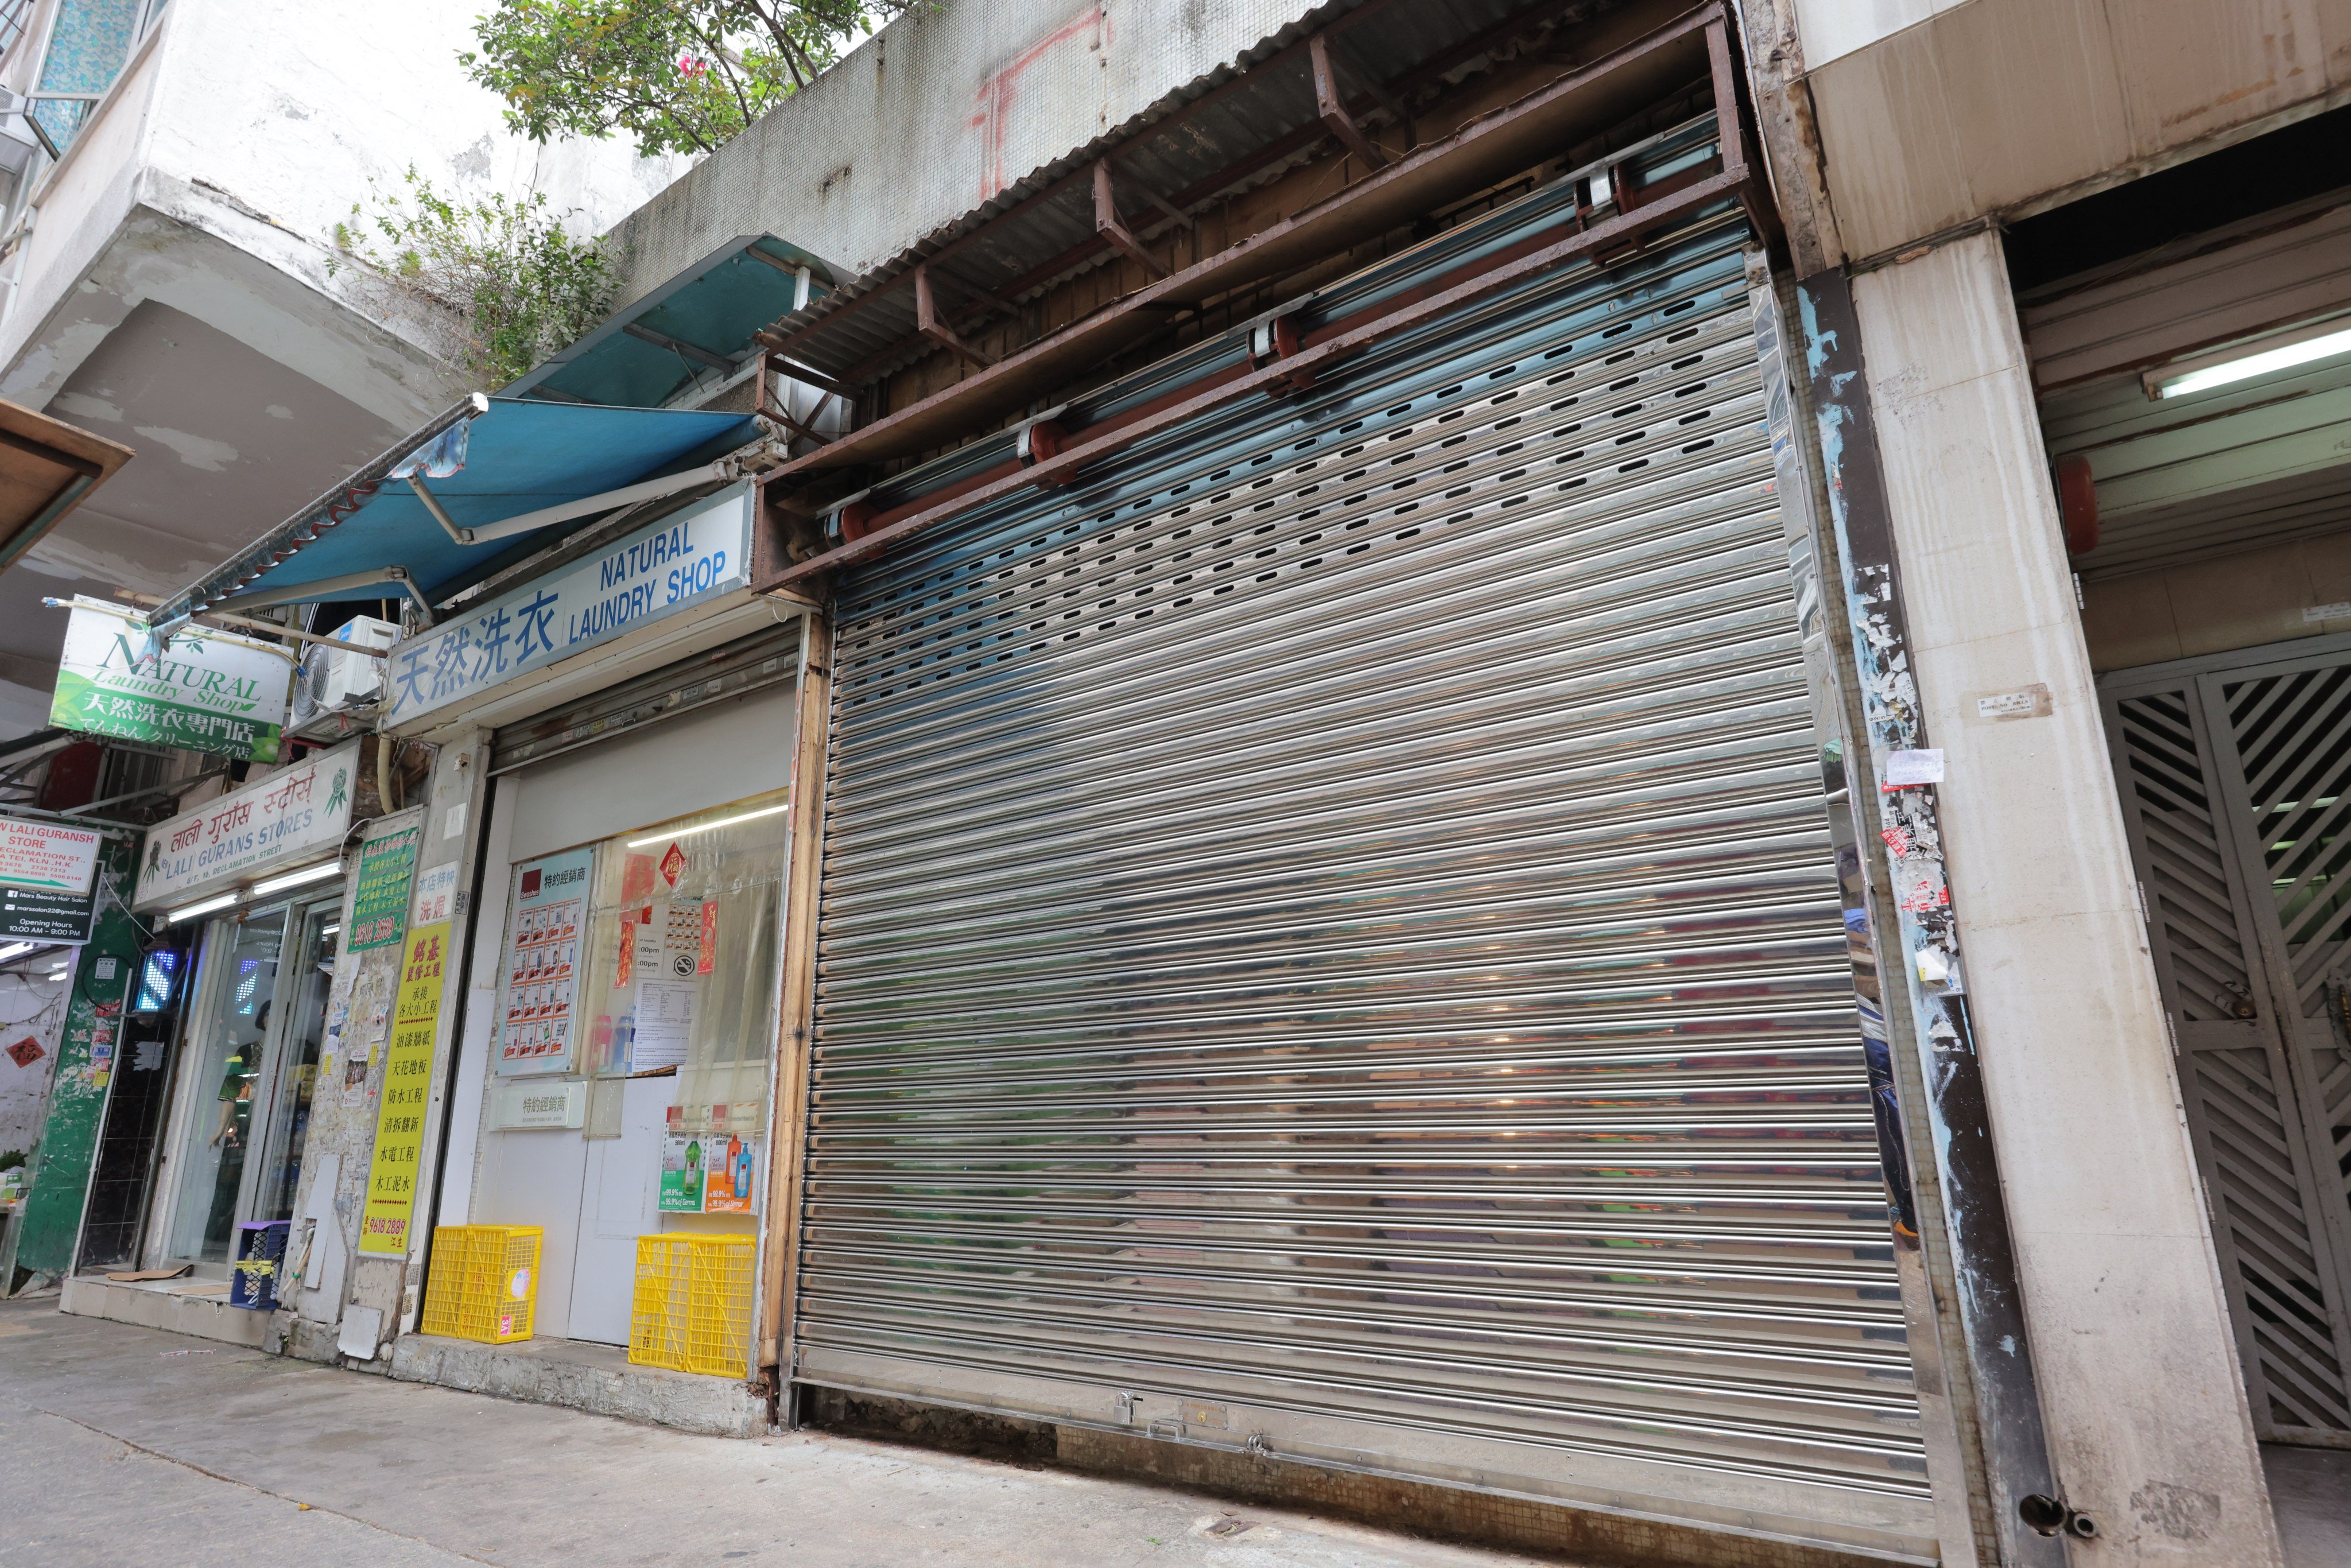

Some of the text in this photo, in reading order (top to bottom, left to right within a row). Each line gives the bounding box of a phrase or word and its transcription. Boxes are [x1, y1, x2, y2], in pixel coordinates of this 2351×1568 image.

[600, 522, 694, 592] NATURAL
[569, 551, 726, 645] LAUNDRY SHOP
[391, 590, 558, 715] 天然洗衣
[96, 633, 262, 701] NATURAL
[93, 668, 247, 712] Laundry Shop
[82, 691, 255, 743] 天然洗衣專門店
[149, 730, 250, 759] クリーニング店
[8, 836, 46, 849] STORE
[10, 824, 35, 835] LALI
[37, 828, 95, 844] GURANSH
[171, 819, 203, 852] लाली
[166, 809, 313, 880] LALI GURANS STORES
[212, 855, 256, 876] RECLAMATION
[259, 844, 283, 859] STREET
[669, 858, 678, 873] 福
[418, 868, 455, 894] 本店特快
[544, 867, 586, 889] 特約經銷商
[36, 894, 57, 902] Beauty
[521, 889, 540, 899] Swashes
[17, 906, 89, 917] marssalon22@gmail.com
[9, 925, 29, 933] 10:00
[20, 918, 72, 928] Opening Hours
[355, 916, 394, 946] 9618 2889
[413, 934, 440, 964] 銘基
[406, 961, 441, 983] 裝修工程
[412, 986, 428, 1001] 承接
[399, 999, 437, 1018] 各大小工程
[391, 1058, 427, 1076] 天花地板
[387, 1088, 423, 1105] 防水工程
[523, 1095, 566, 1113] 特約經銷商
[384, 1116, 419, 1134] 清拆翻新
[379, 1146, 414, 1162] 水電工程
[375, 1175, 410, 1192] 木工泥水
[369, 1217, 406, 1235] 9618 2889
[390, 1236, 402, 1248] 江生
[501, 1319, 509, 1332] 3A
